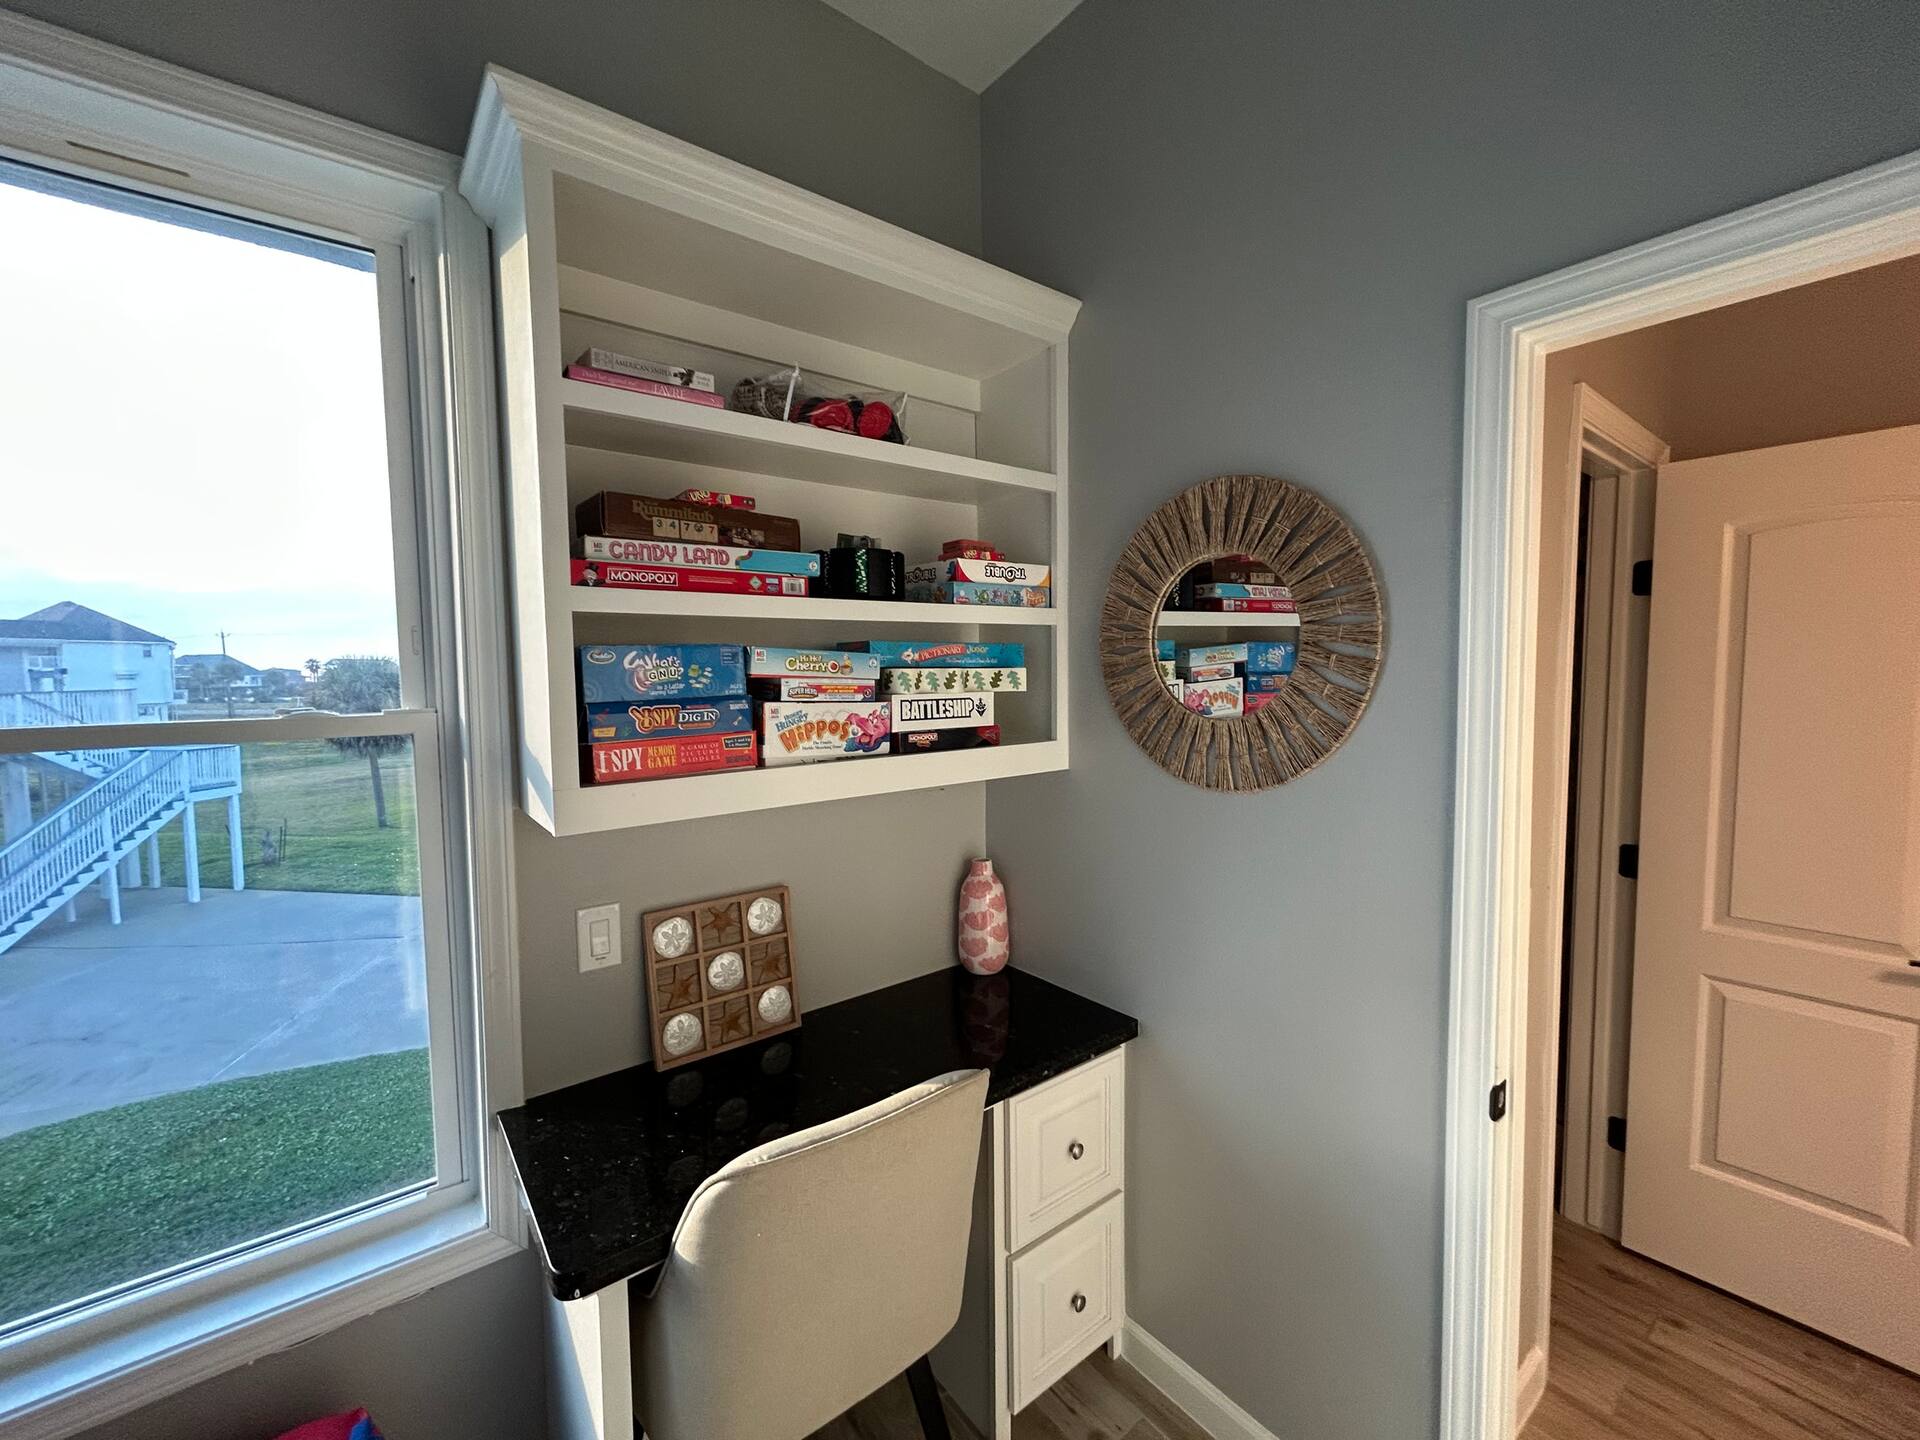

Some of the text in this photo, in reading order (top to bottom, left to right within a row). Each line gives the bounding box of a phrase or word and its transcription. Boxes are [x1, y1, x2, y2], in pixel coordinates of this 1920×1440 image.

[614, 359, 650, 373] AMERICAN
[689, 489, 710, 502] UNO
[632, 499, 714, 523] Rummikub
[655, 519, 716, 536] 3 4 7 7
[608, 540, 731, 566] CANDY LAND
[963, 549, 977, 559] UNO
[609, 569, 677, 585] MONOPOLY
[905, 567, 937, 584] TROUBLE
[984, 564, 1027, 582] TROUBLE
[623, 650, 682, 670] What's
[920, 645, 962, 661] PICTIONARY
[901, 697, 974, 720] BATTLESHIP
[653, 707, 679, 727] SPY
[679, 712, 701, 722] DIG
[704, 711, 717, 721] IN
[779, 719, 851, 753] HIPPOS
[909, 733, 938, 741] MONOPOLY
[647, 744, 677, 757] MEMORY
[680, 748, 720, 757] PICTURE
[598, 747, 643, 774] I SPY
[647, 756, 678, 768] GAME
[680, 755, 721, 764] RIDDLES
